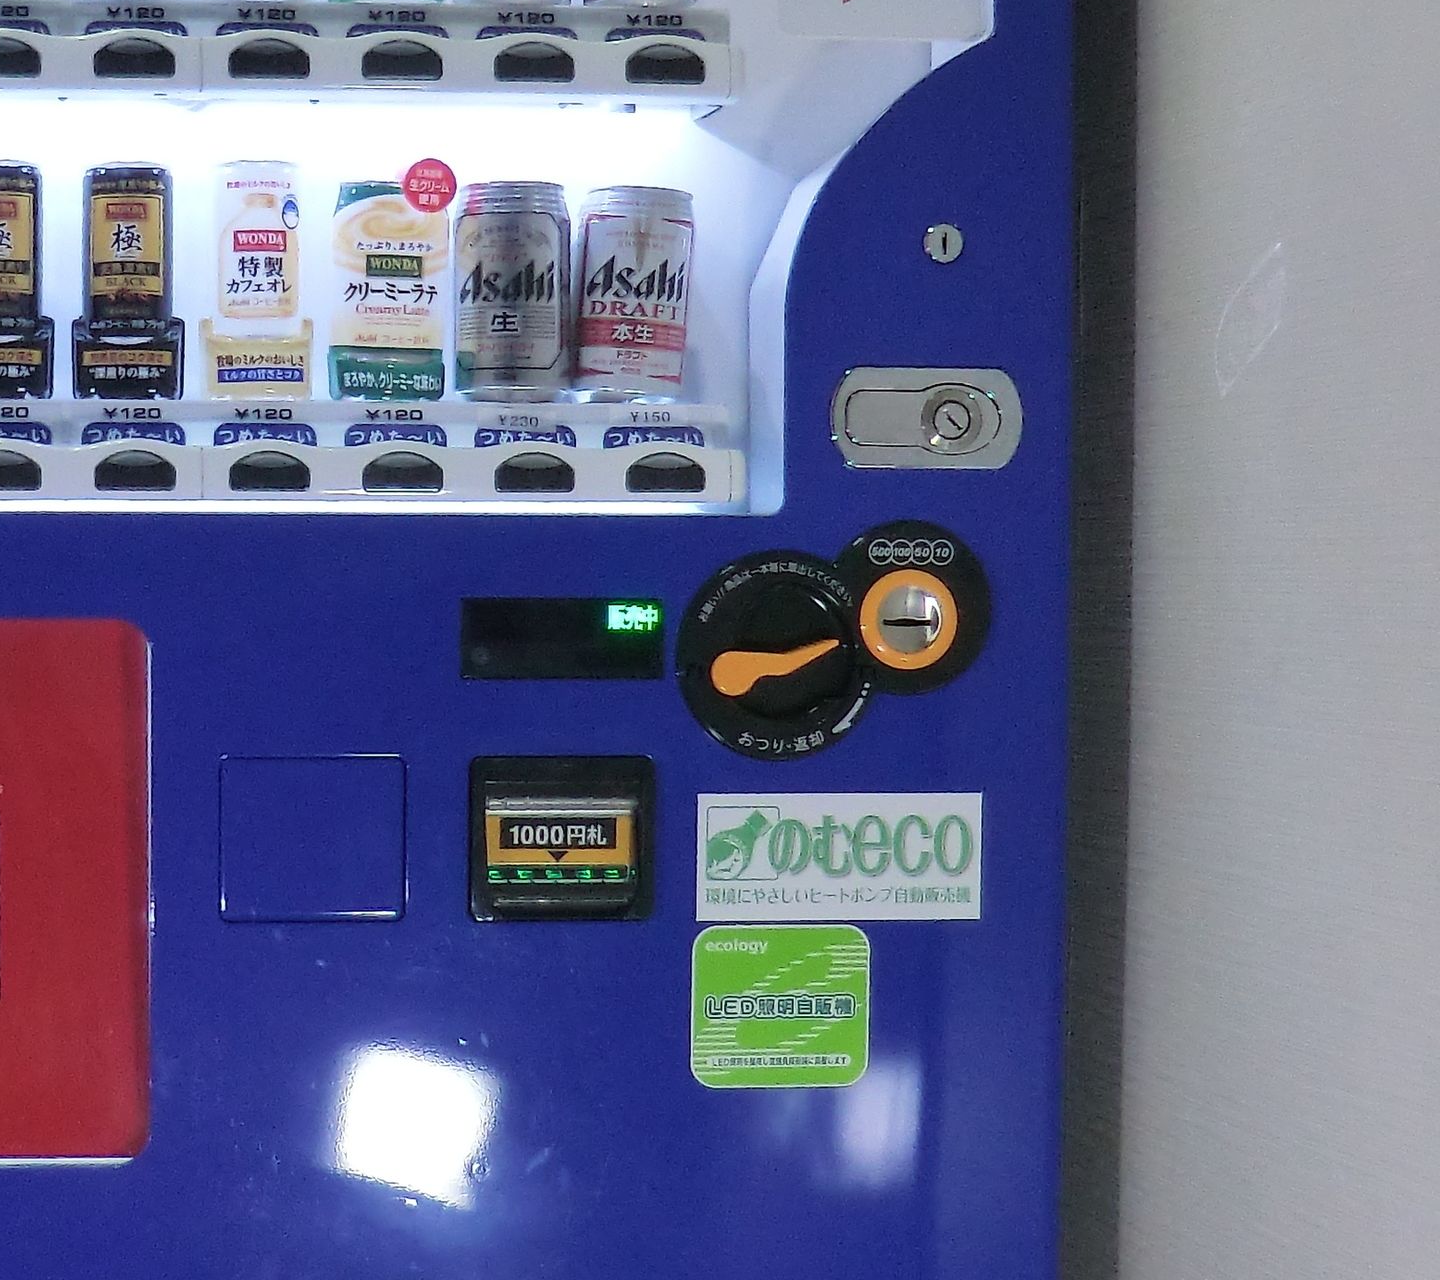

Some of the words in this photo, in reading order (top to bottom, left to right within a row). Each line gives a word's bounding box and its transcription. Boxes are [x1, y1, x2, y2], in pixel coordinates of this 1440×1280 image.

[110, 223, 143, 253] 極
[237, 231, 284, 246] WONDA
[237, 255, 284, 279] 特製
[369, 257, 419, 272] WONDA
[104, 275, 148, 288] BLACK
[226, 278, 293, 296] カフェオレ
[459, 259, 556, 305] Asahi
[586, 255, 687, 303] Asahi
[343, 281, 439, 304] クリーミーラテ
[588, 299, 680, 322] DRAFT
[490, 311, 519, 333] 生
[611, 323, 656, 345] 本生
[933, 547, 951, 558] 10
[607, 602, 659, 632] 販売中
[508, 823, 608, 847] 1000円札
[704, 886, 972, 906] 環境にやさしいヒートポンプ自動販売機
[704, 938, 769, 955] ecology
[706, 995, 856, 1019] LED照明自販機
